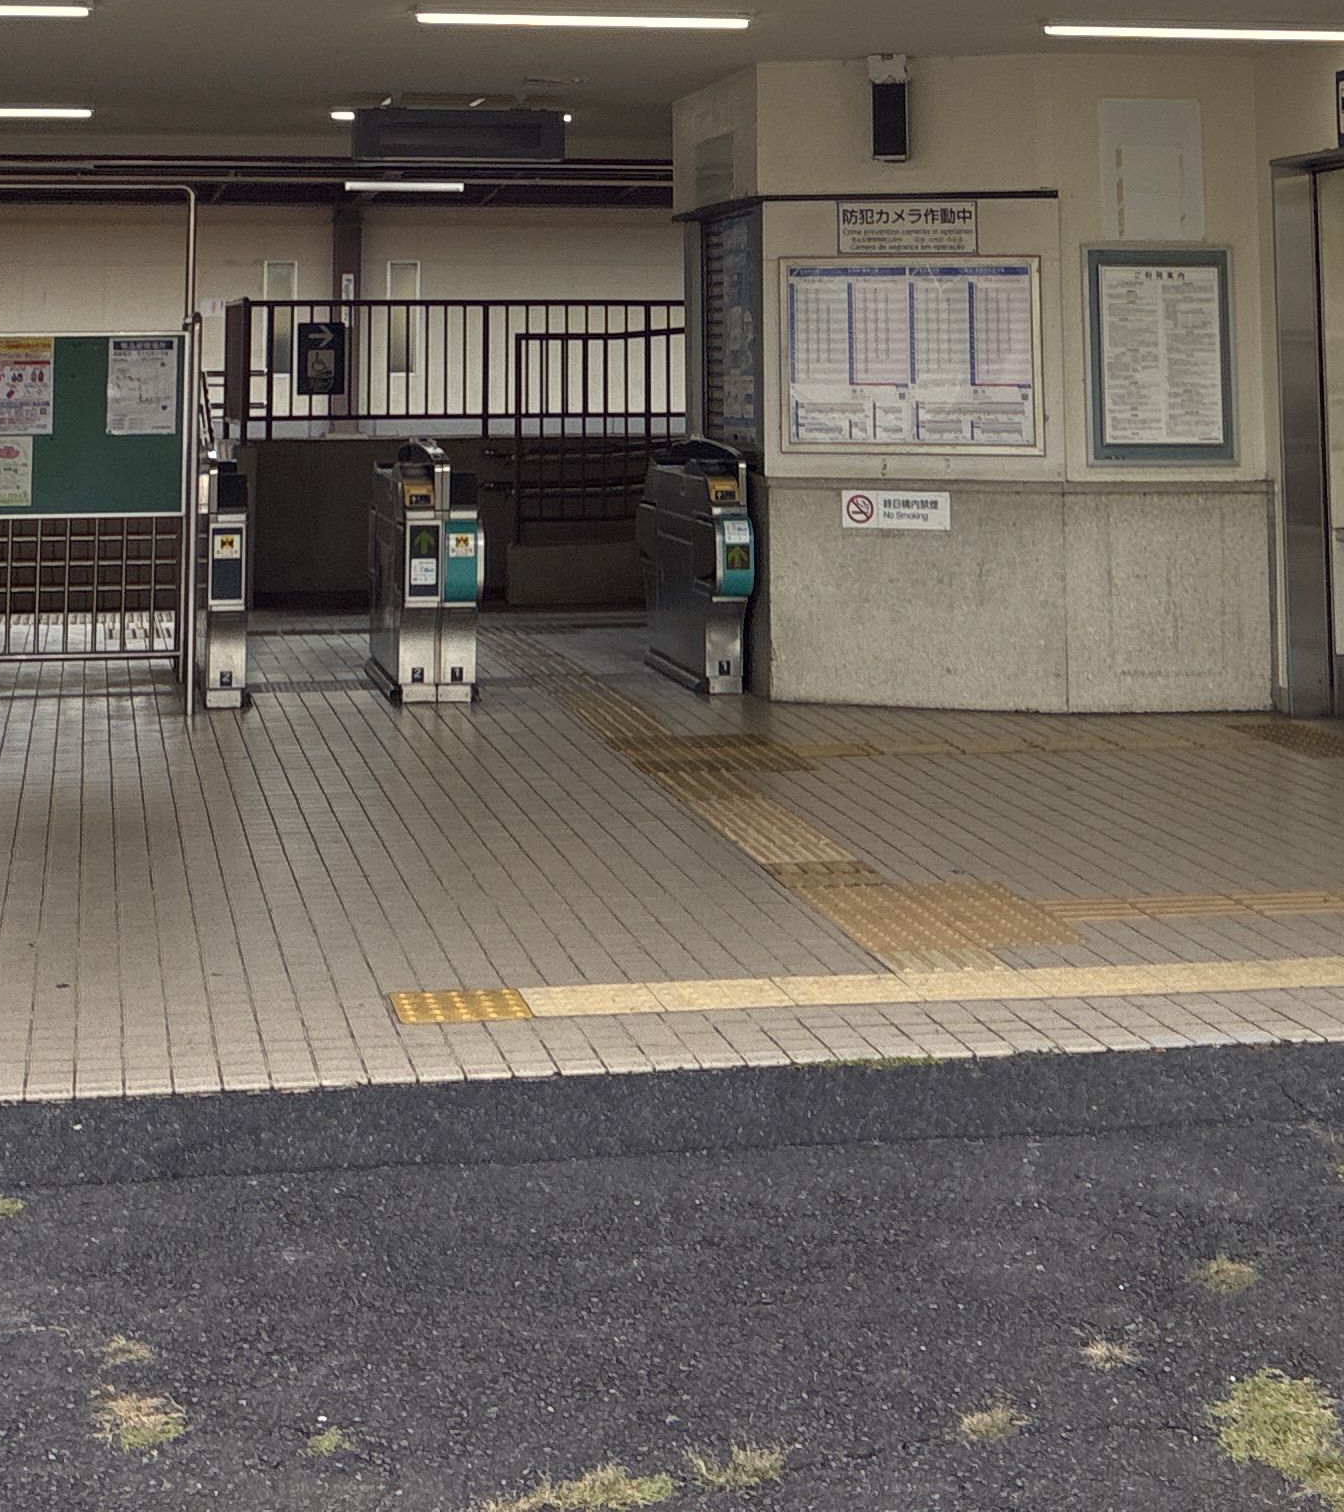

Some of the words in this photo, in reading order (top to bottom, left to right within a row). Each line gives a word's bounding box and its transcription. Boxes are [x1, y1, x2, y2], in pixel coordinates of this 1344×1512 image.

[842, 207, 973, 225] 防犯カメラ作動中
[883, 511, 894, 519] No
